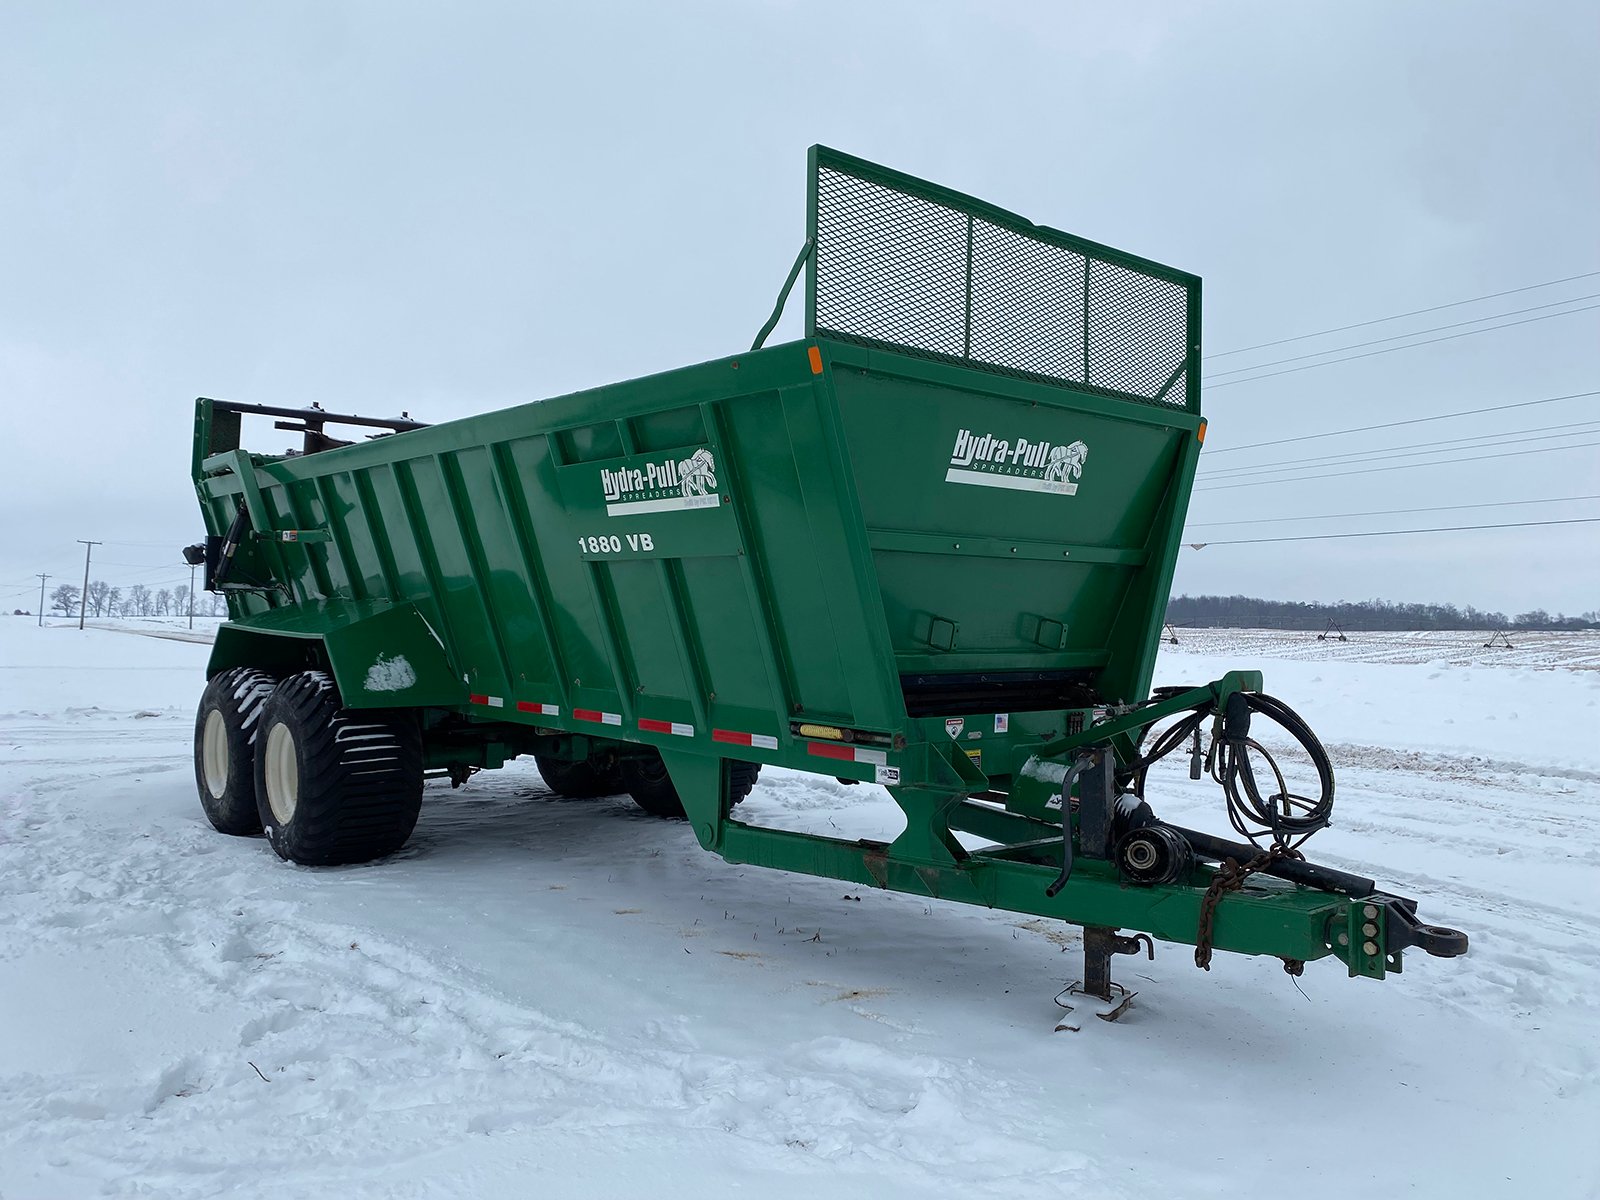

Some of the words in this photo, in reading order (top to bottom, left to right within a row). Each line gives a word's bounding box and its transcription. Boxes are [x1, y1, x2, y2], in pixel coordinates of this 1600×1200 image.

[950, 429, 1049, 467] Hydra-Pull
[601, 460, 677, 500] Hydra-Pull
[973, 462, 1044, 478] SPREADERS
[622, 488, 681, 501] SPREADERS
[578, 536, 621, 553] 1880
[626, 533, 654, 551] VB
